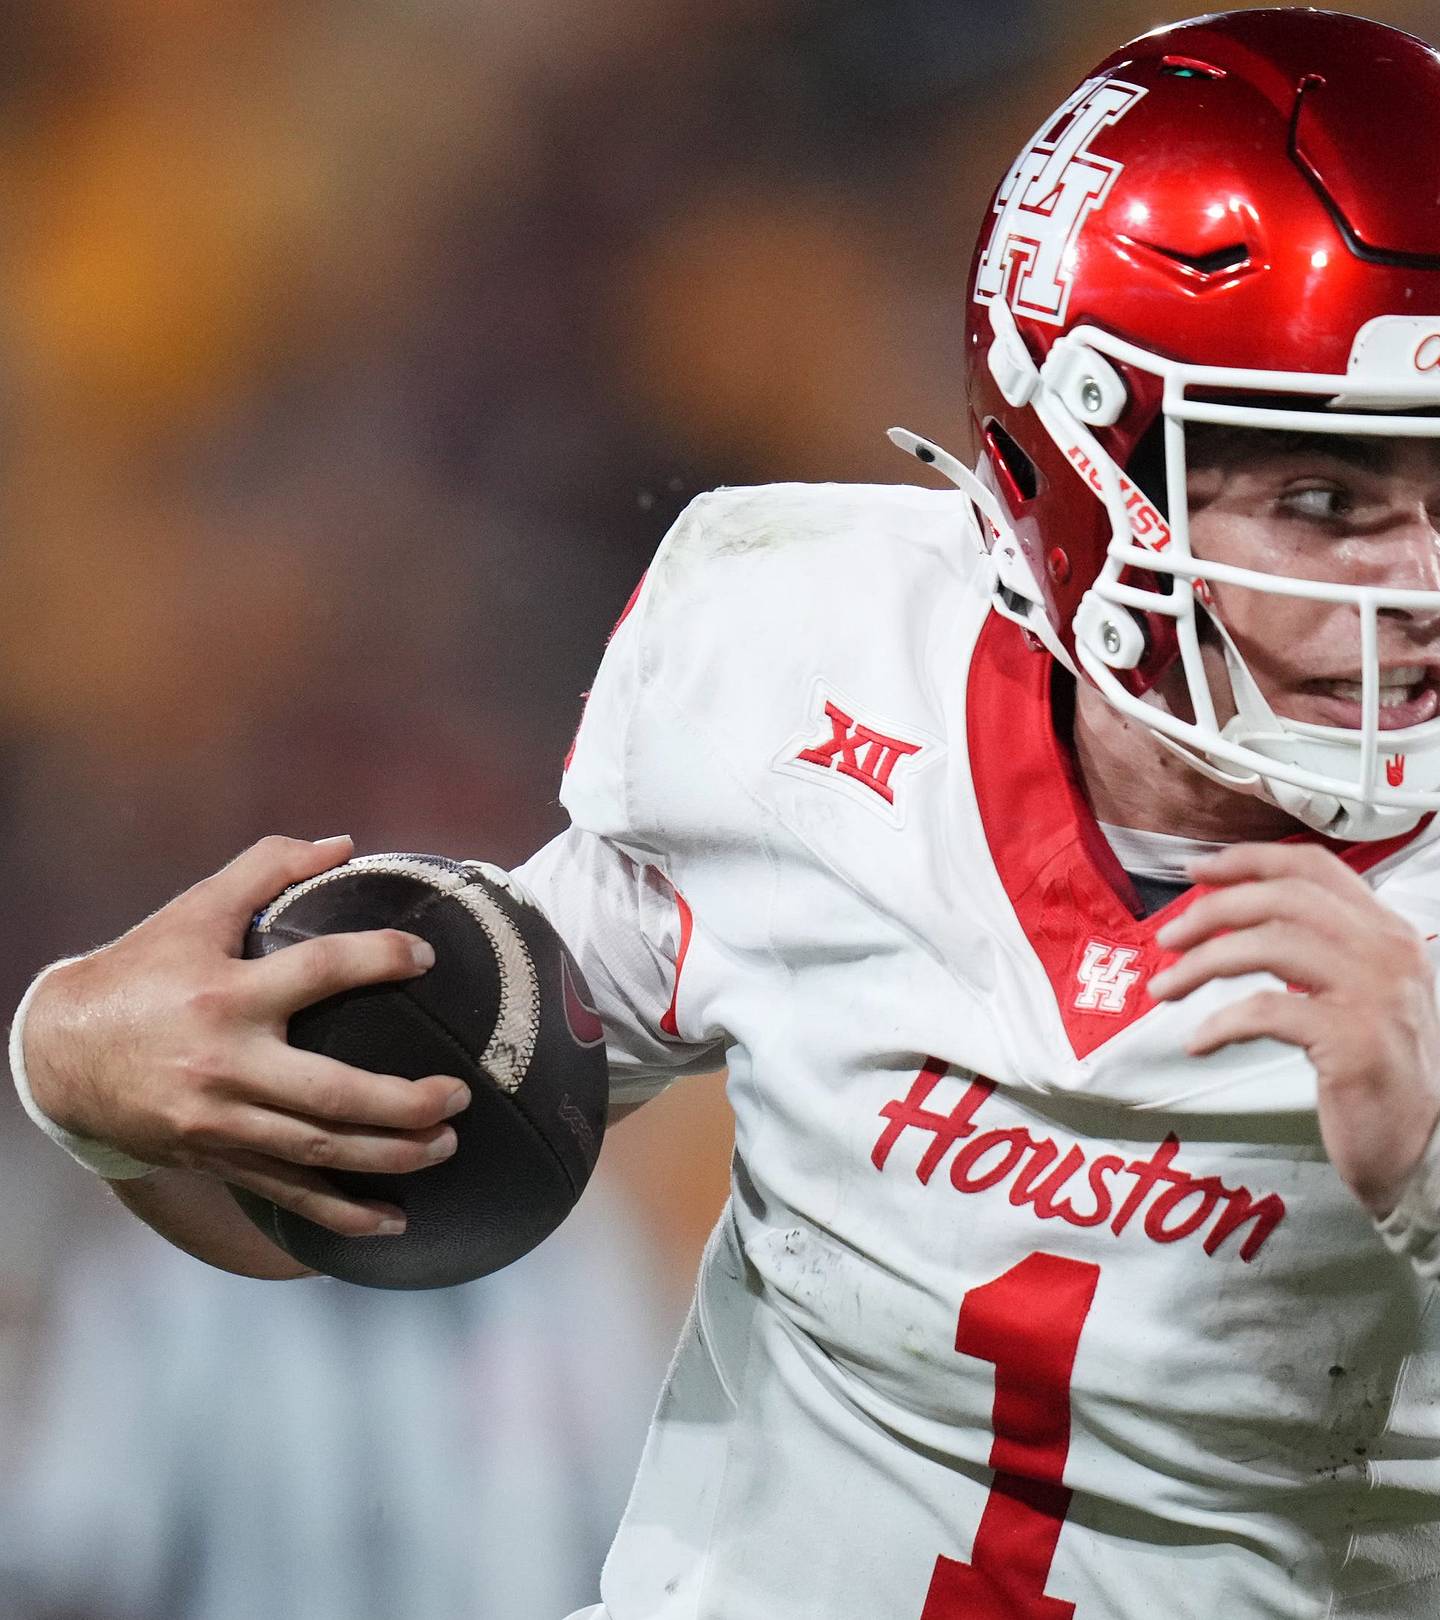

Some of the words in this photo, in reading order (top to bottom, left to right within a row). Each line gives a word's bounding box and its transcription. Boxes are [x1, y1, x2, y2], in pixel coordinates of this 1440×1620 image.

[795, 699, 923, 806] XII
[1074, 941, 1141, 1013] UH
[870, 1057, 1287, 1264] Houston
[919, 1250, 1101, 1620] 1
